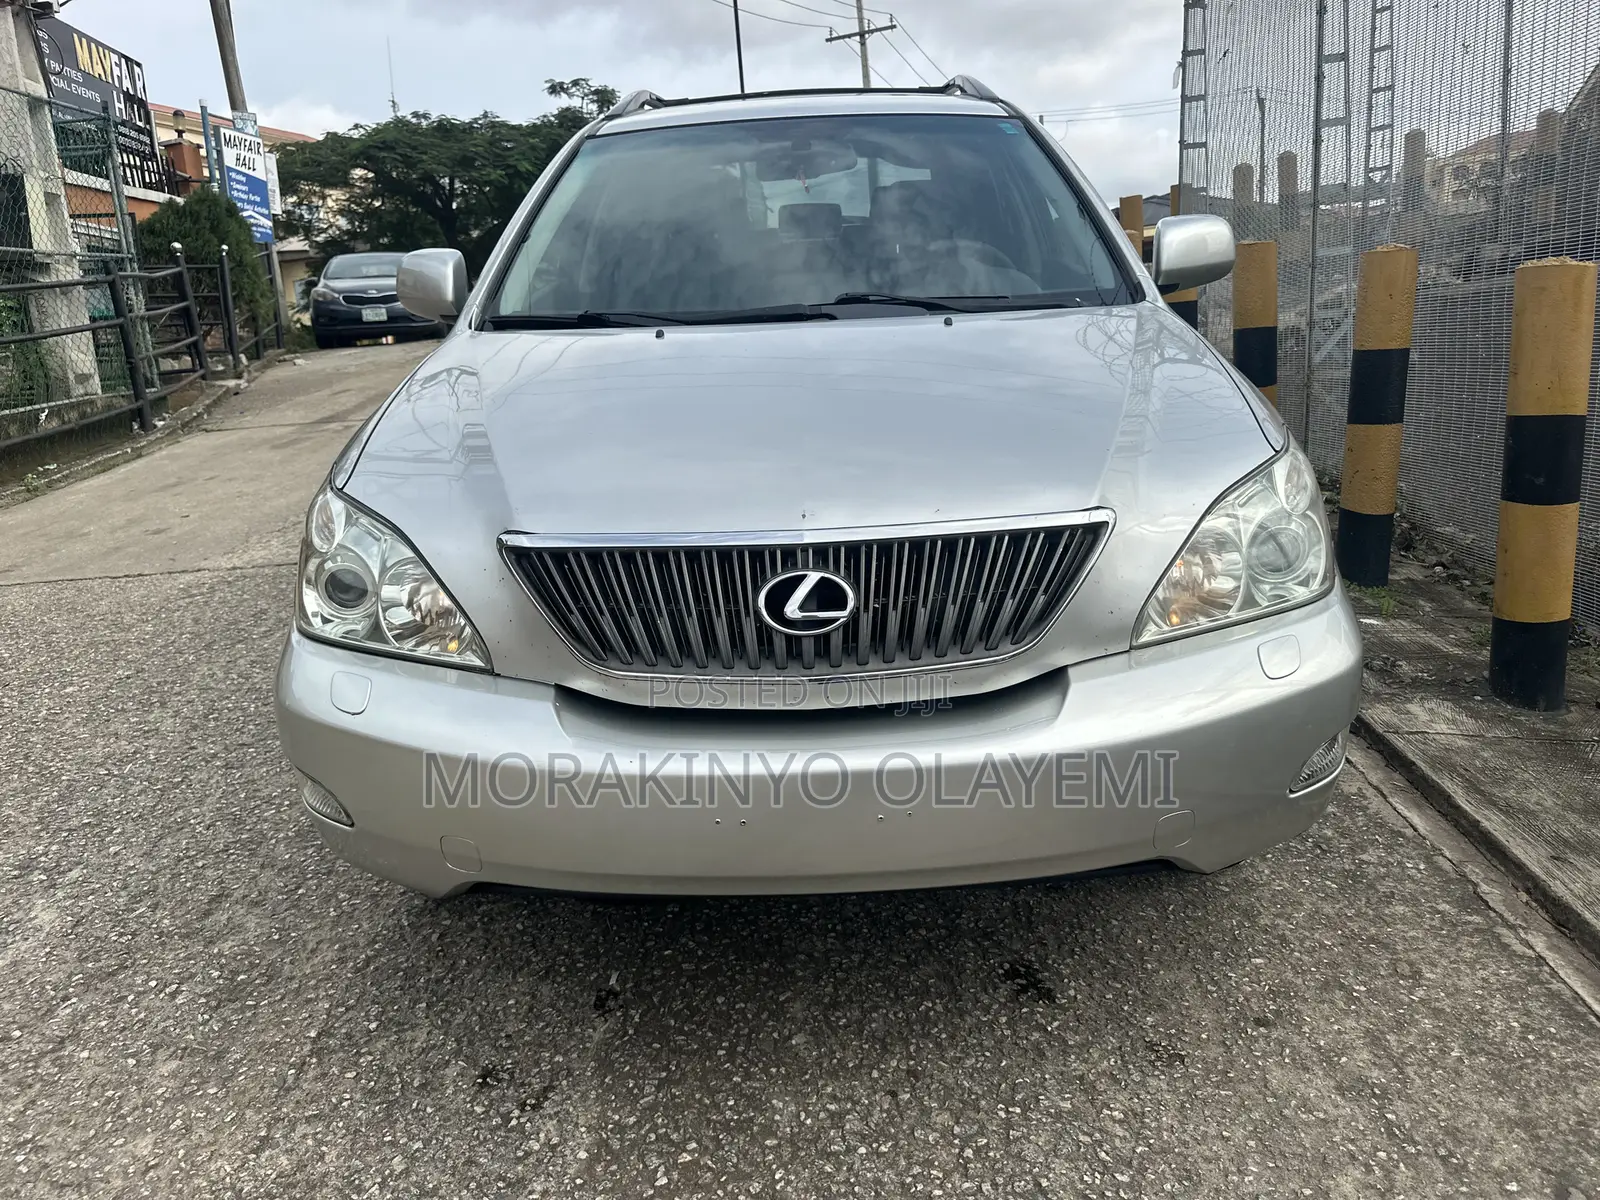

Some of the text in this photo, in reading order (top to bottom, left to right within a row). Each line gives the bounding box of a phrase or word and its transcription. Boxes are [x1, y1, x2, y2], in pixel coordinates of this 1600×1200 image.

[73, 32, 146, 102] MAYFAIR
[71, 83, 101, 103] EVENTS
[223, 132, 262, 156] MAYFAIR
[235, 152, 256, 172] HALL
